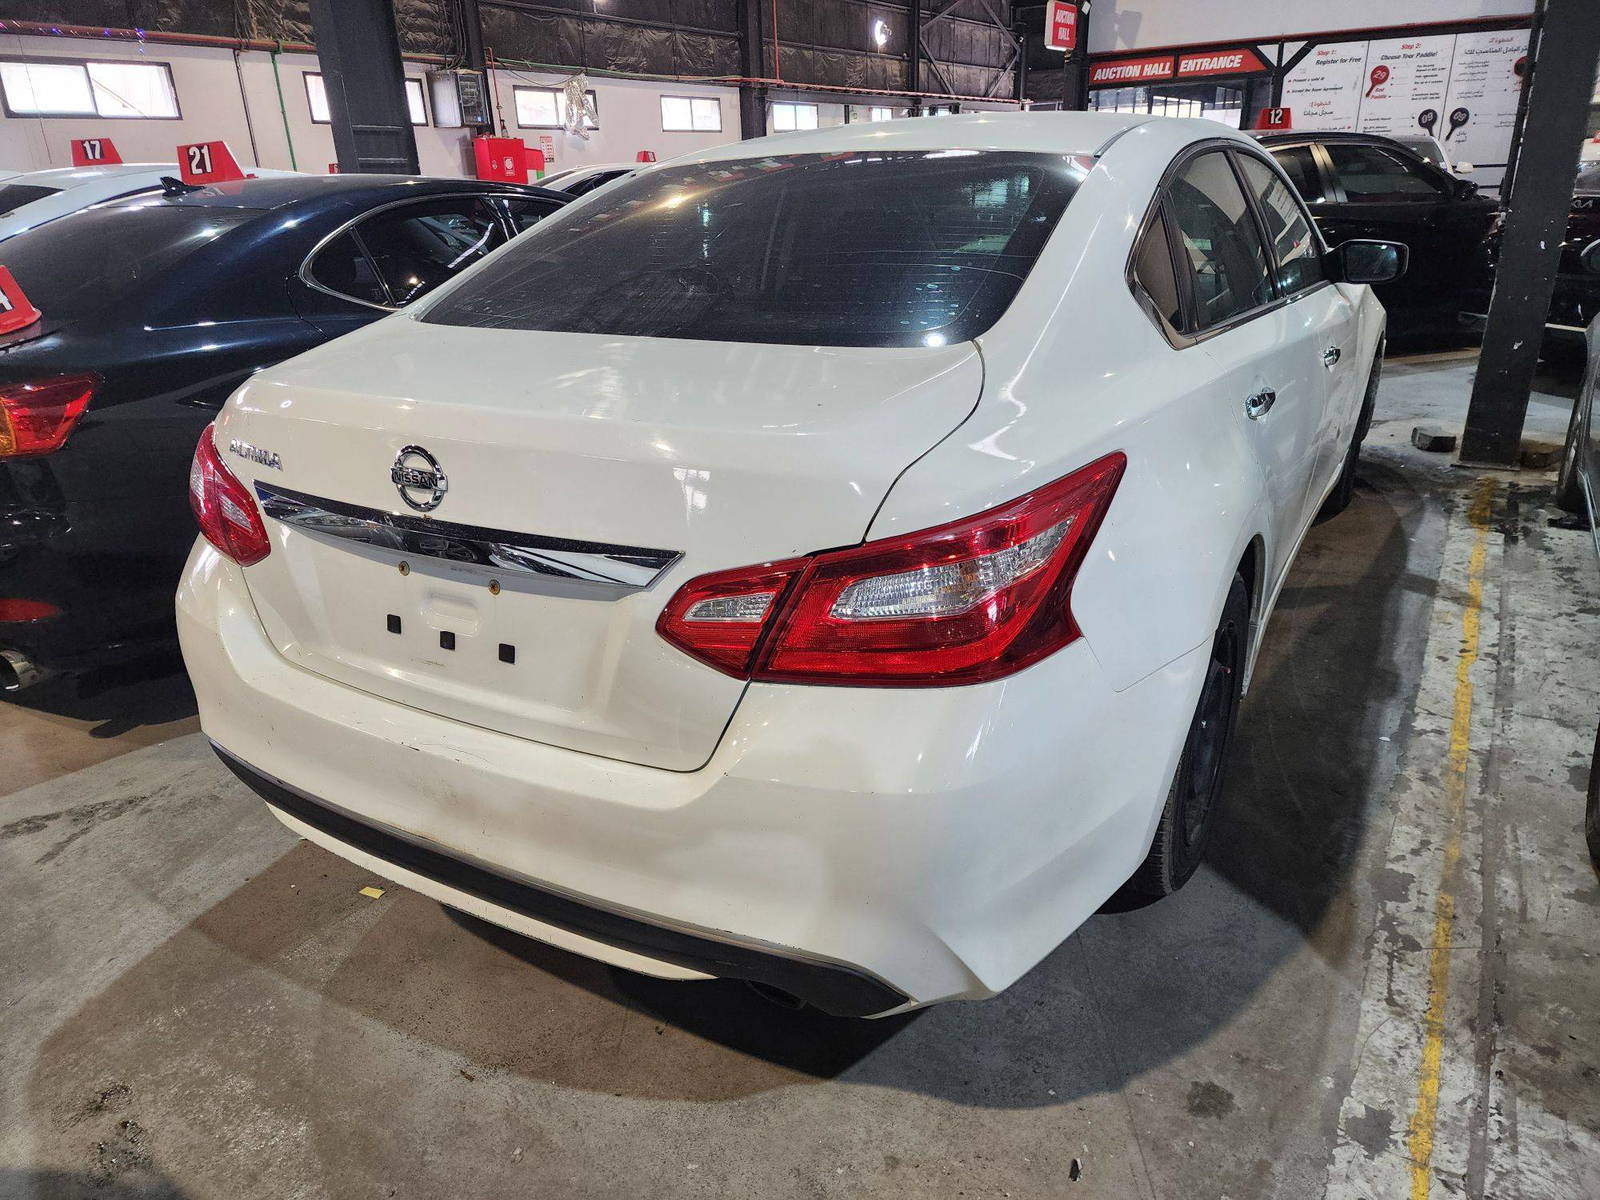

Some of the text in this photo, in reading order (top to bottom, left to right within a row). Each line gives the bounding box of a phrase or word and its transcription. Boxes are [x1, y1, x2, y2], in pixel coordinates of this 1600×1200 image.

[1055, 9, 1075, 25] AUCTION
[1058, 27, 1071, 41] HALL
[1094, 54, 1244, 81] AUCTION HALL ENTRANCE
[1270, 108, 1283, 124] 12
[1422, 112, 1433, 124] 09
[83, 140, 101, 160] 17
[188, 145, 213, 175] 21
[229, 438, 283, 472] ALTIMA
[394, 468, 438, 488] NISSAN
